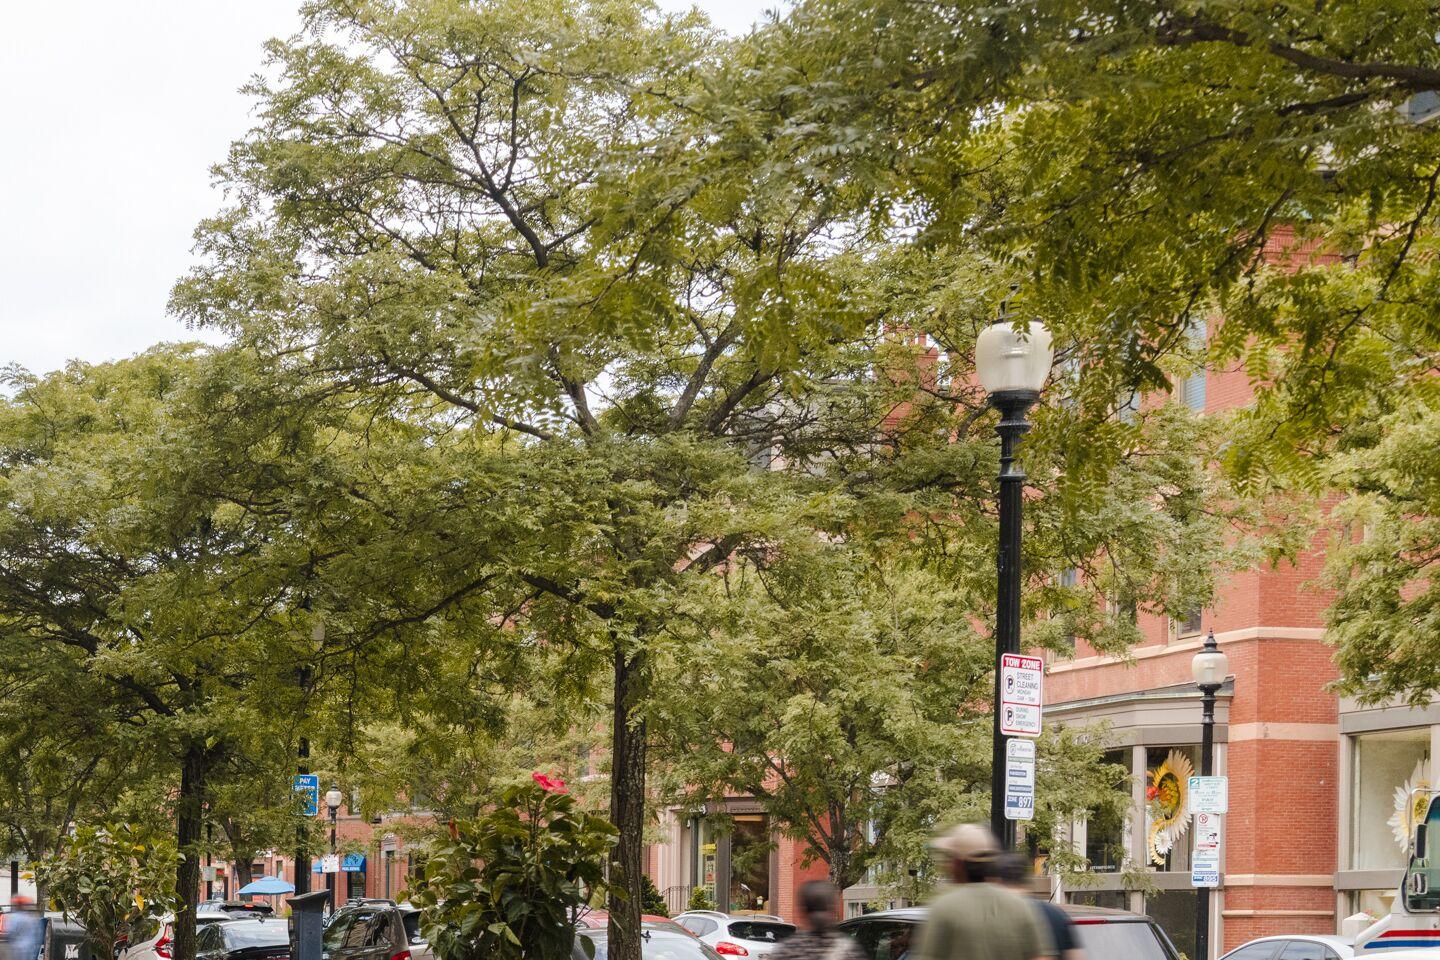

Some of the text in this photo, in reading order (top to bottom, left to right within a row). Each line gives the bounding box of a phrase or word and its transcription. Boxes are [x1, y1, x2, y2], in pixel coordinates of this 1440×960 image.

[1005, 657, 1040, 670] TOW ZONE
[1016, 672, 1034, 680] STREET
[1016, 681, 1038, 690] CLEANING
[1018, 796, 1032, 808] 897
